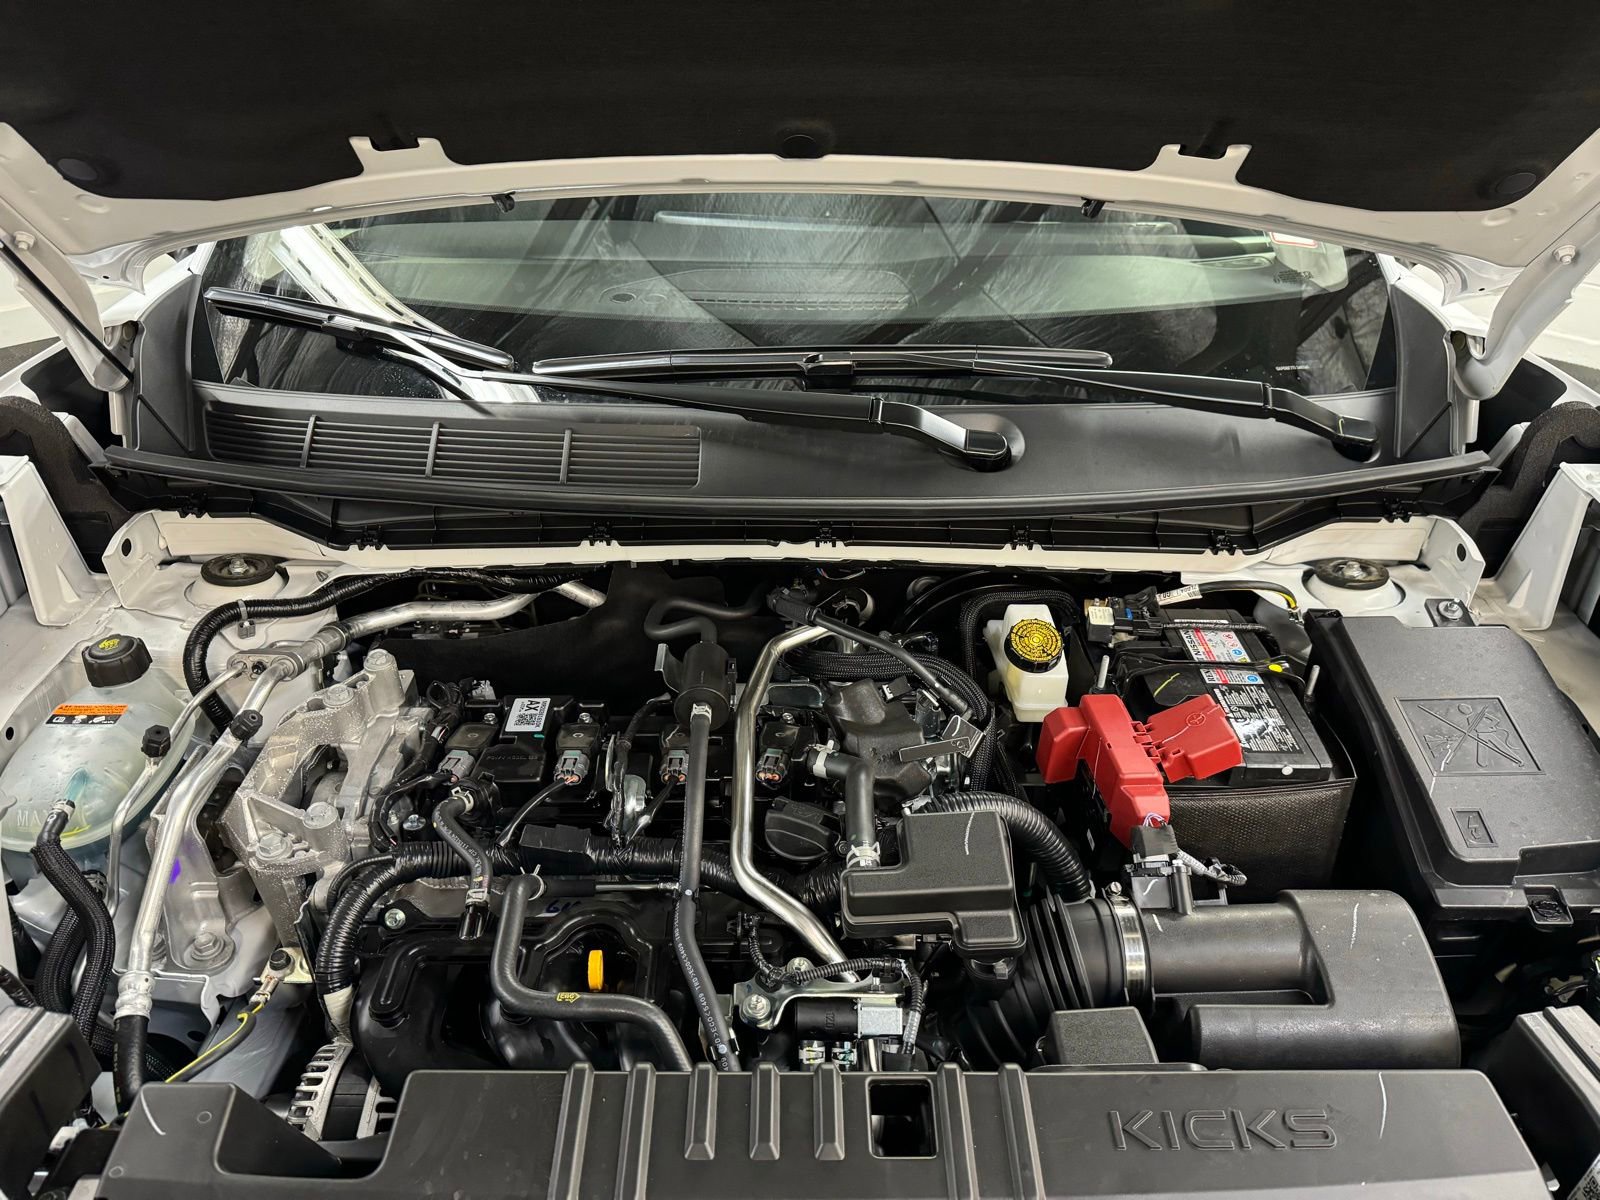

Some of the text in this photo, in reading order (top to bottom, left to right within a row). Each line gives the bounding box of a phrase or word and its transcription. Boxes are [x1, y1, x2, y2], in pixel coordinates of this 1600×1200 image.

[1183, 630, 1202, 656] NISSAN
[524, 699, 541, 712] AX
[1108, 1109, 1338, 1151] KICKS
